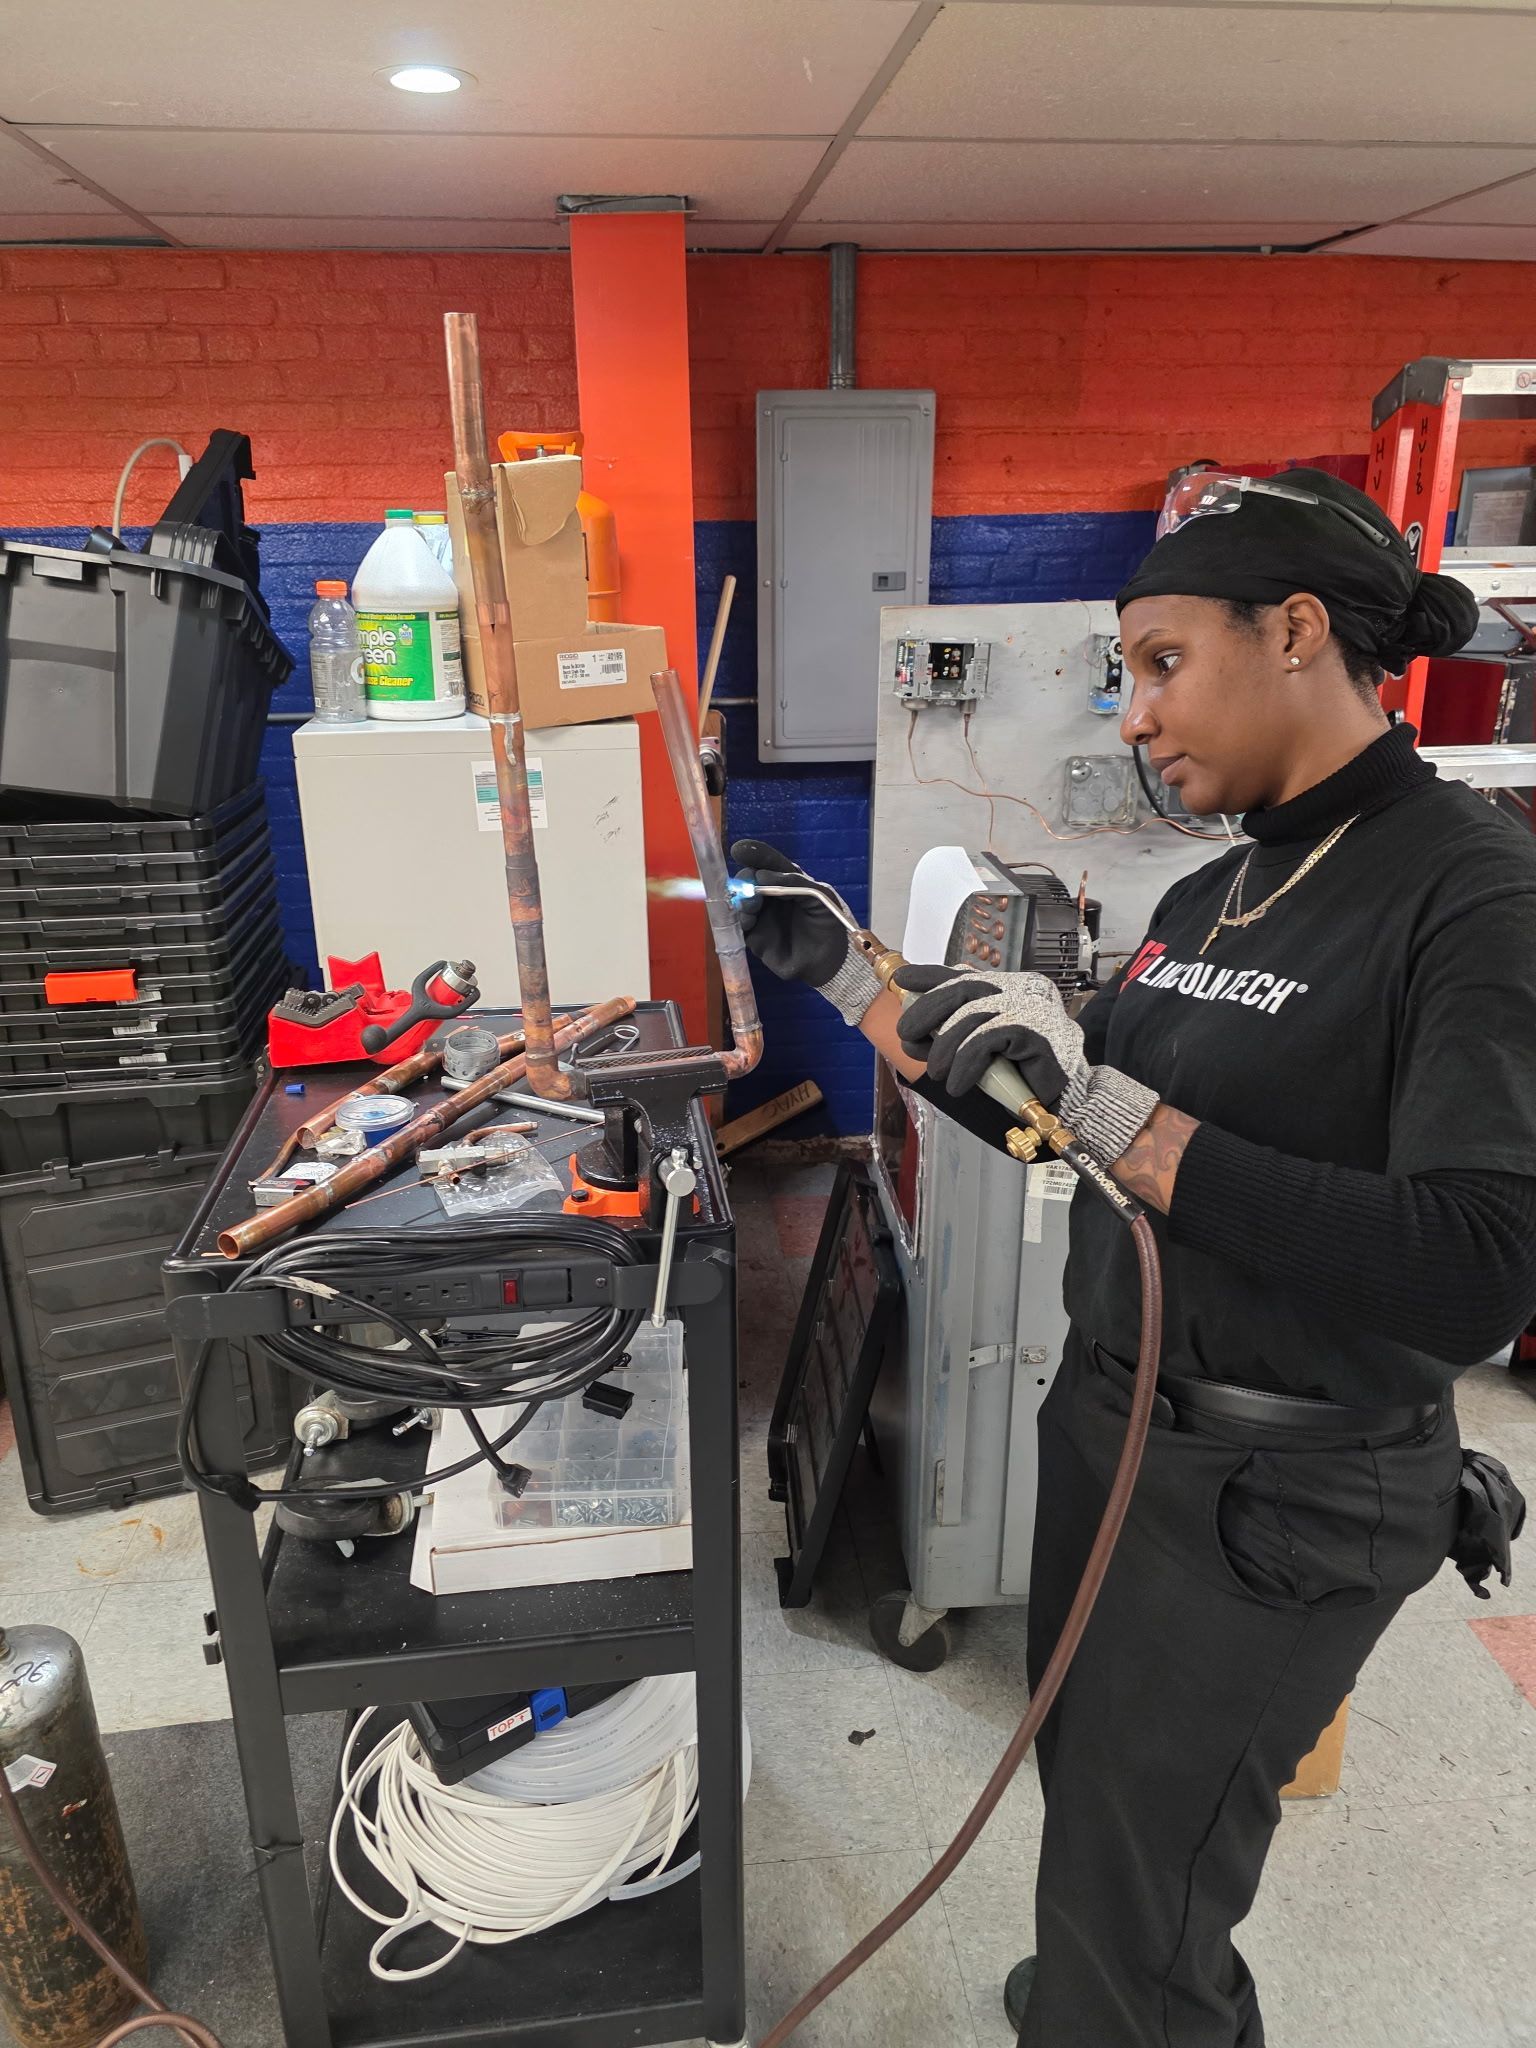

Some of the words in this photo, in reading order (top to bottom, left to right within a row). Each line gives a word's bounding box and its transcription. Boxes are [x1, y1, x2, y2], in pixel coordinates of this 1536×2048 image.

[359, 626, 397, 649] mple
[365, 648, 397, 665] een
[489, 1718, 515, 1737] TOP
